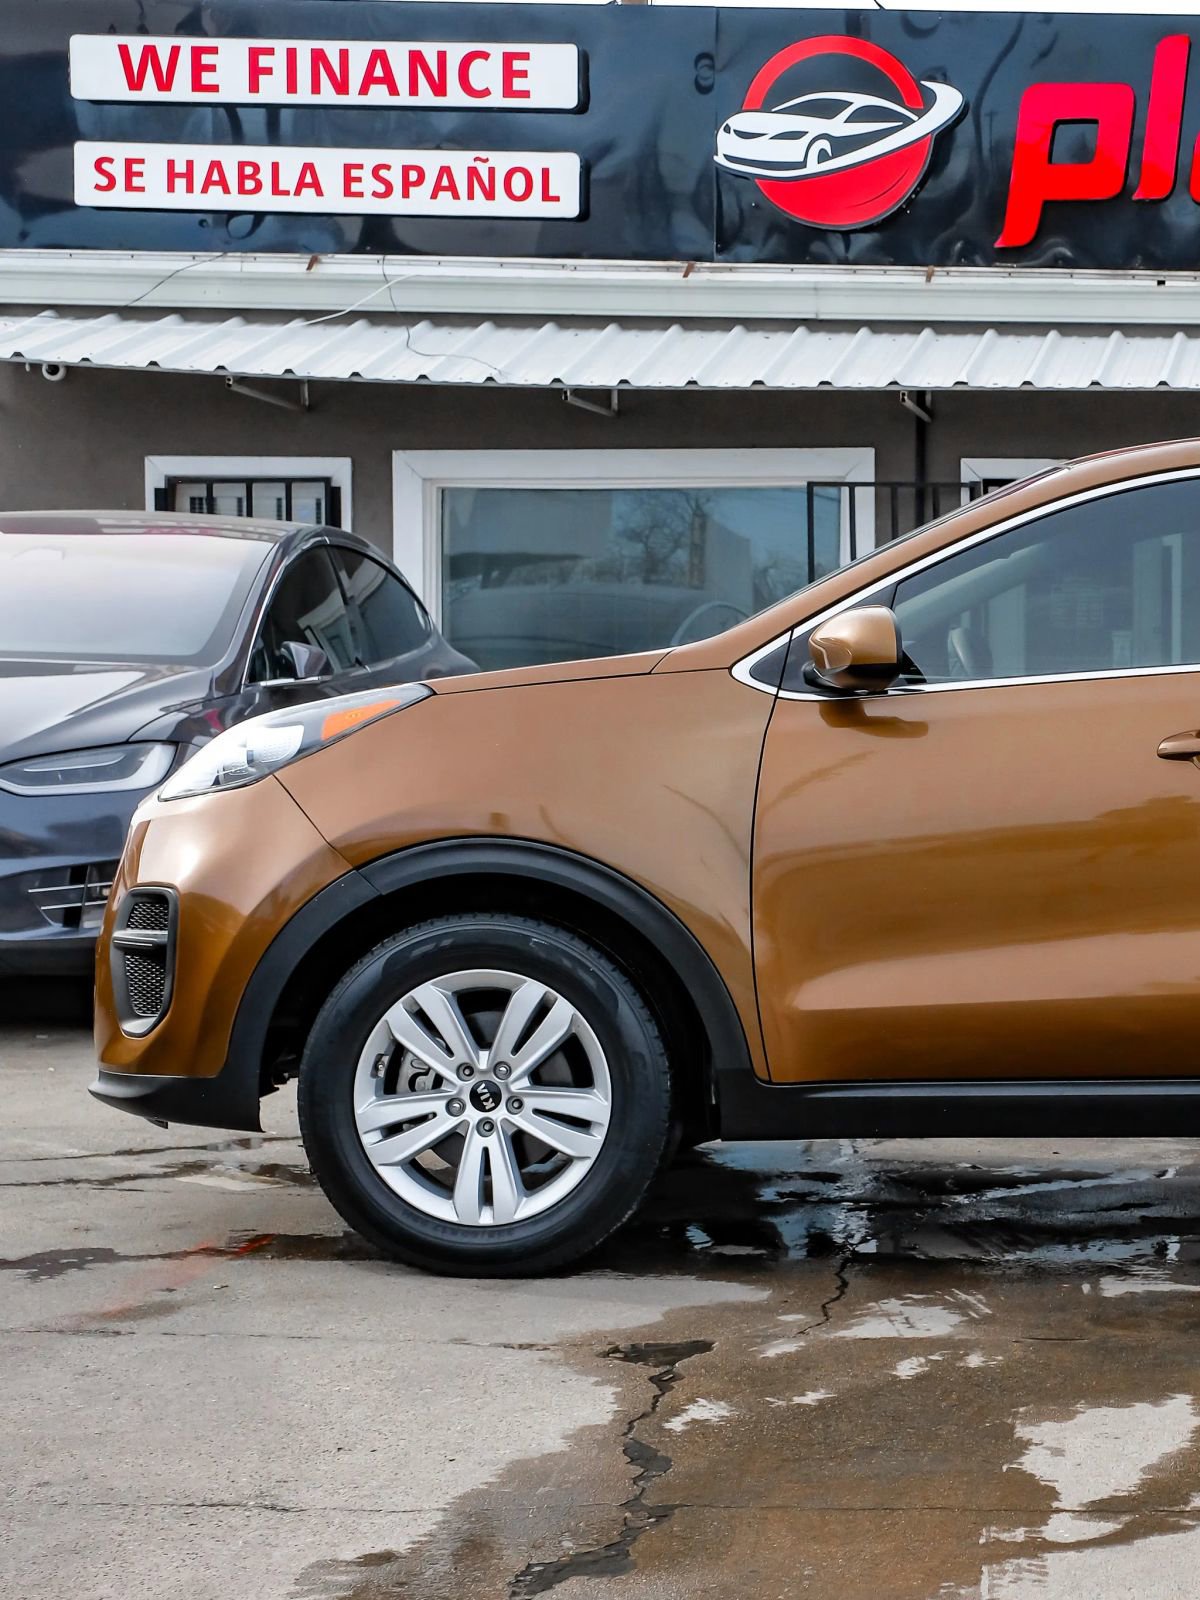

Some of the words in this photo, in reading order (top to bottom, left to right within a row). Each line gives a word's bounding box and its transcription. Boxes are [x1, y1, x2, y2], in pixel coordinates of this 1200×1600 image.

[118, 43, 220, 93] WE
[248, 46, 531, 99] FINANCE
[94, 156, 145, 193] SE
[167, 159, 324, 197] HABLA
[343, 156, 561, 203] ESPAÑOL
[477, 1083, 495, 1110] KIA
